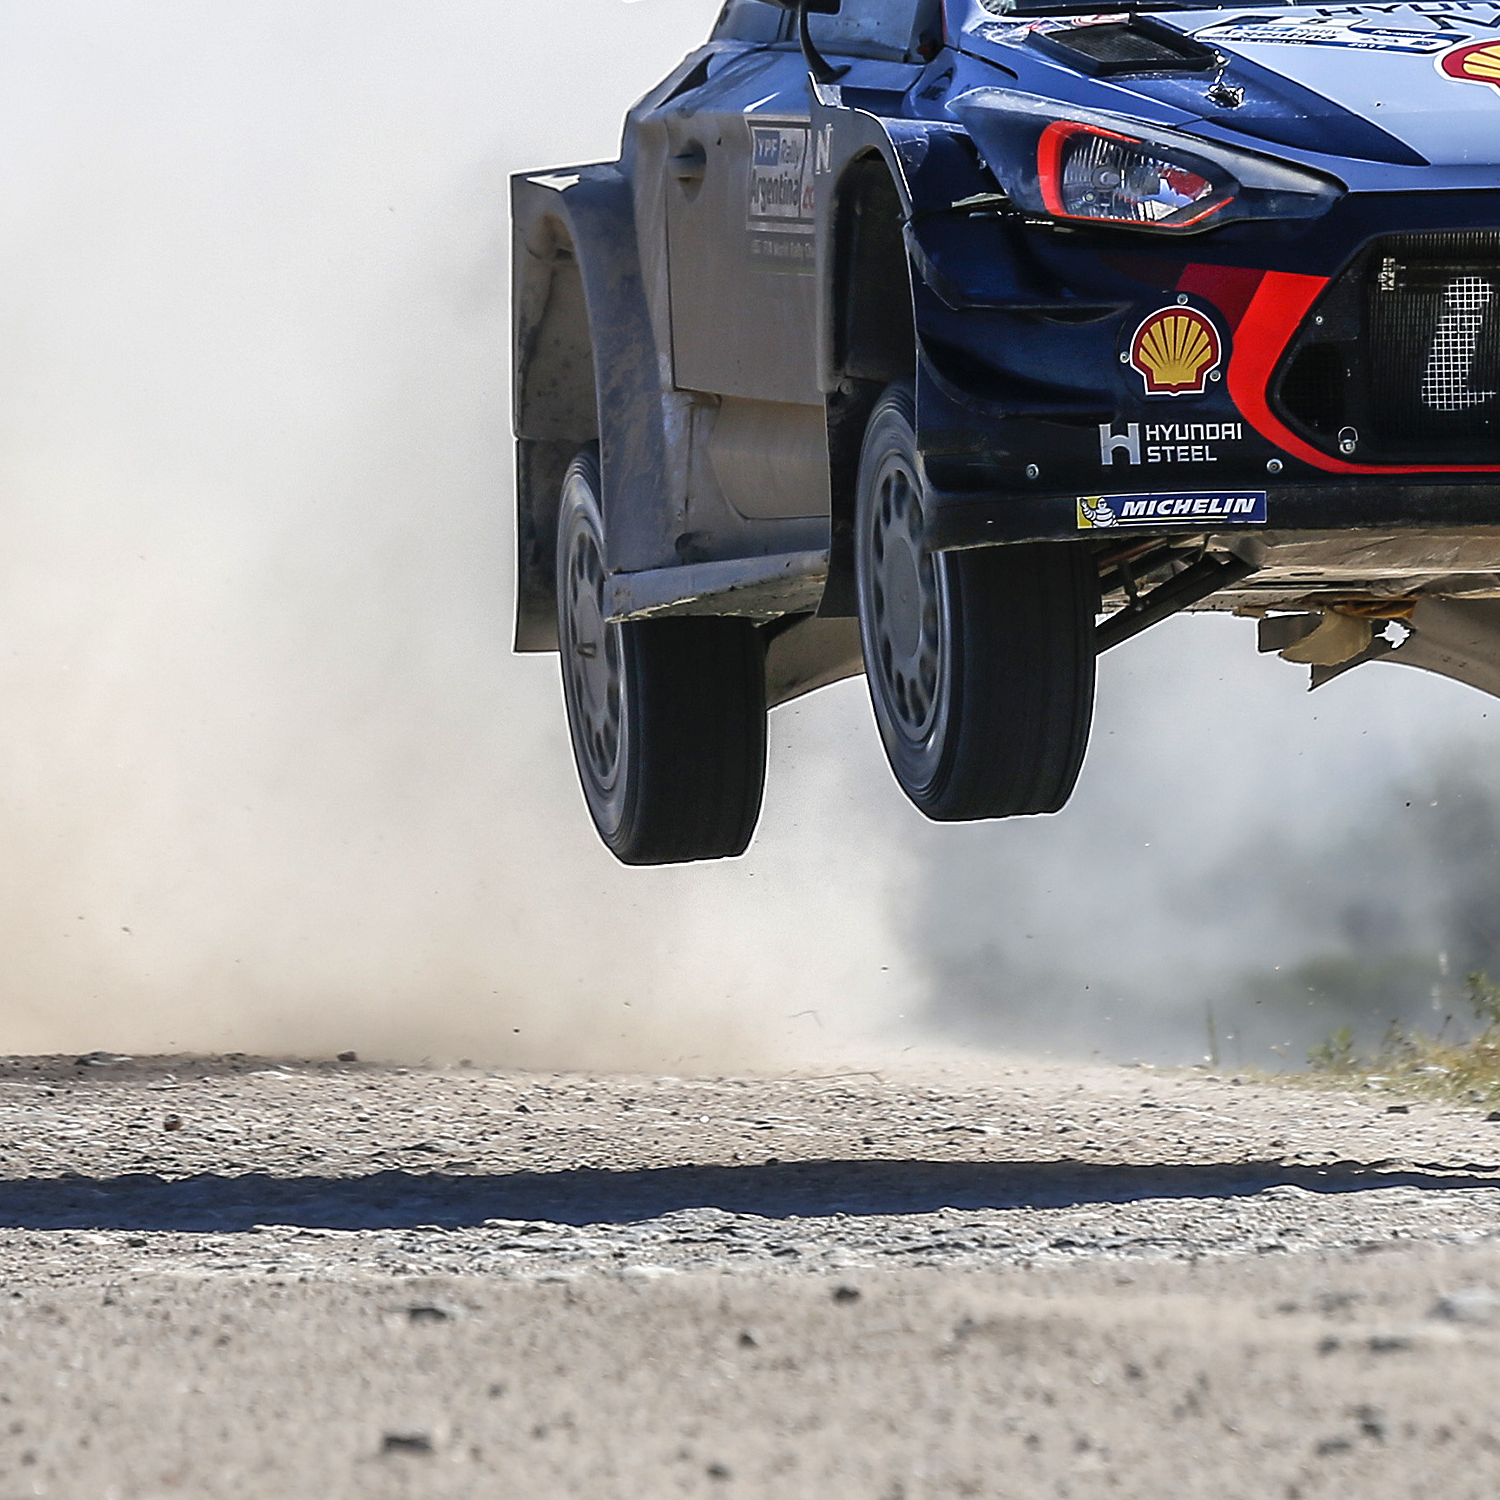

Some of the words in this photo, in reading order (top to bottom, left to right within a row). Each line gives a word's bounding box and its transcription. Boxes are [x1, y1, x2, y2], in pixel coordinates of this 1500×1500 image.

[757, 138, 778, 158] YPF
[1145, 423, 1242, 441] HYUNDAI
[1147, 445, 1218, 463] STEEL
[1121, 498, 1256, 517] MICHELIN
